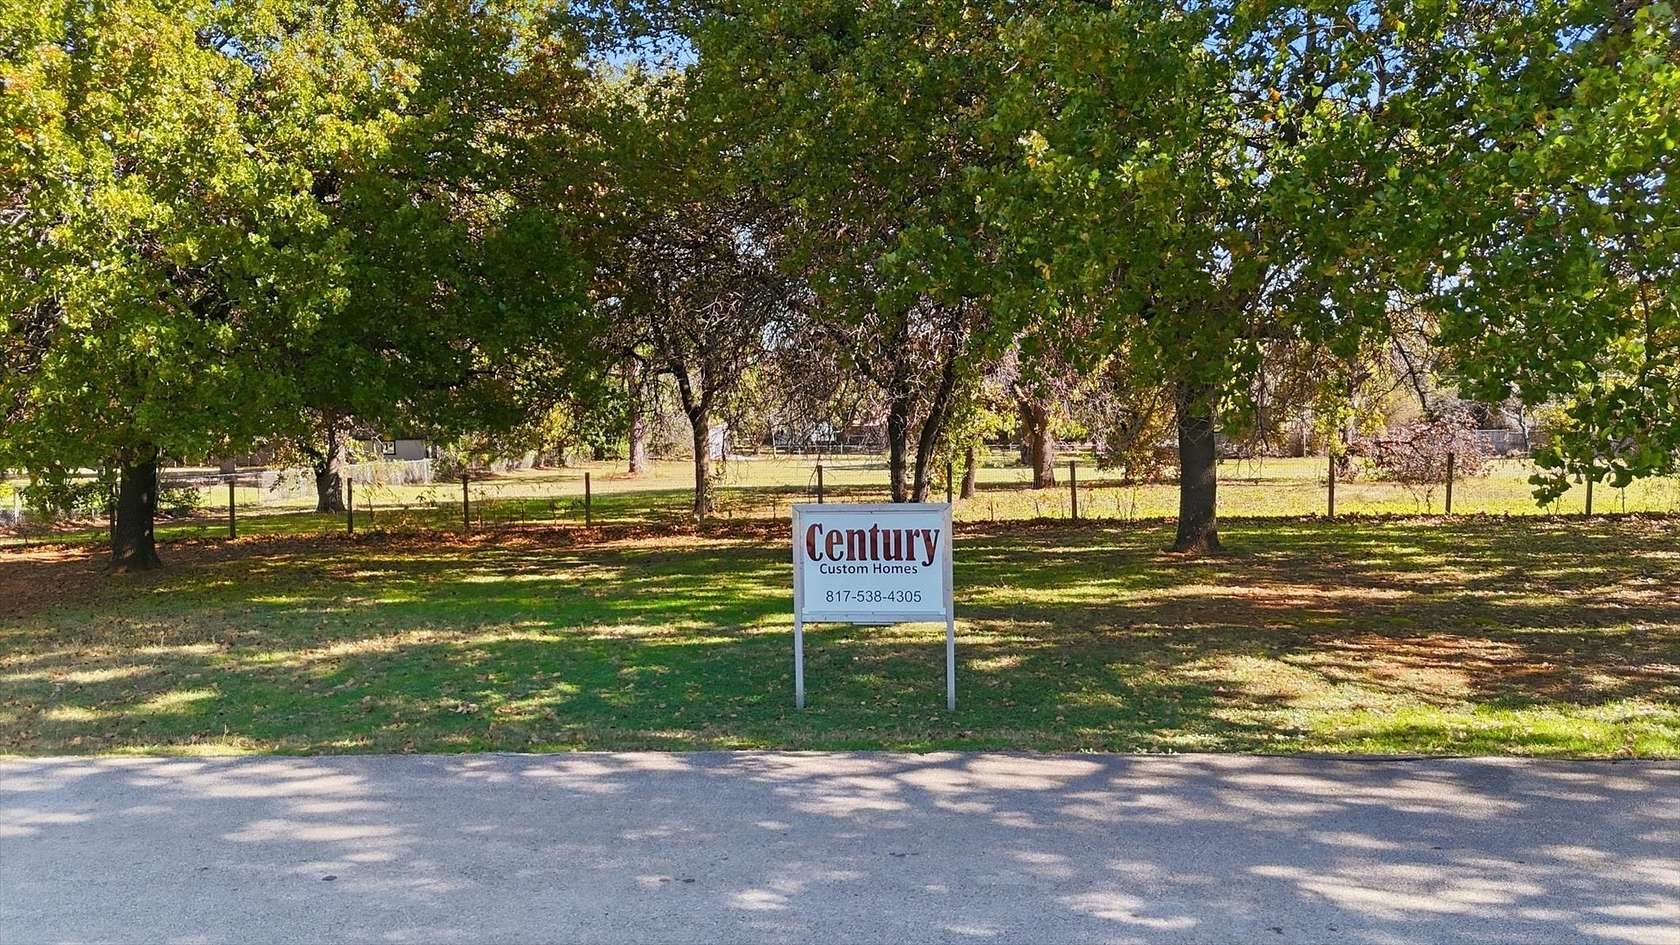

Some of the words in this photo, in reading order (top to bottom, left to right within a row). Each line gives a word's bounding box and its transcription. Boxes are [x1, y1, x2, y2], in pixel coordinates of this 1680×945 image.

[806, 522, 940, 567] Century
[819, 563, 868, 574] Custom
[873, 563, 918, 574] Homes
[826, 590, 922, 603] 817-538-4305
